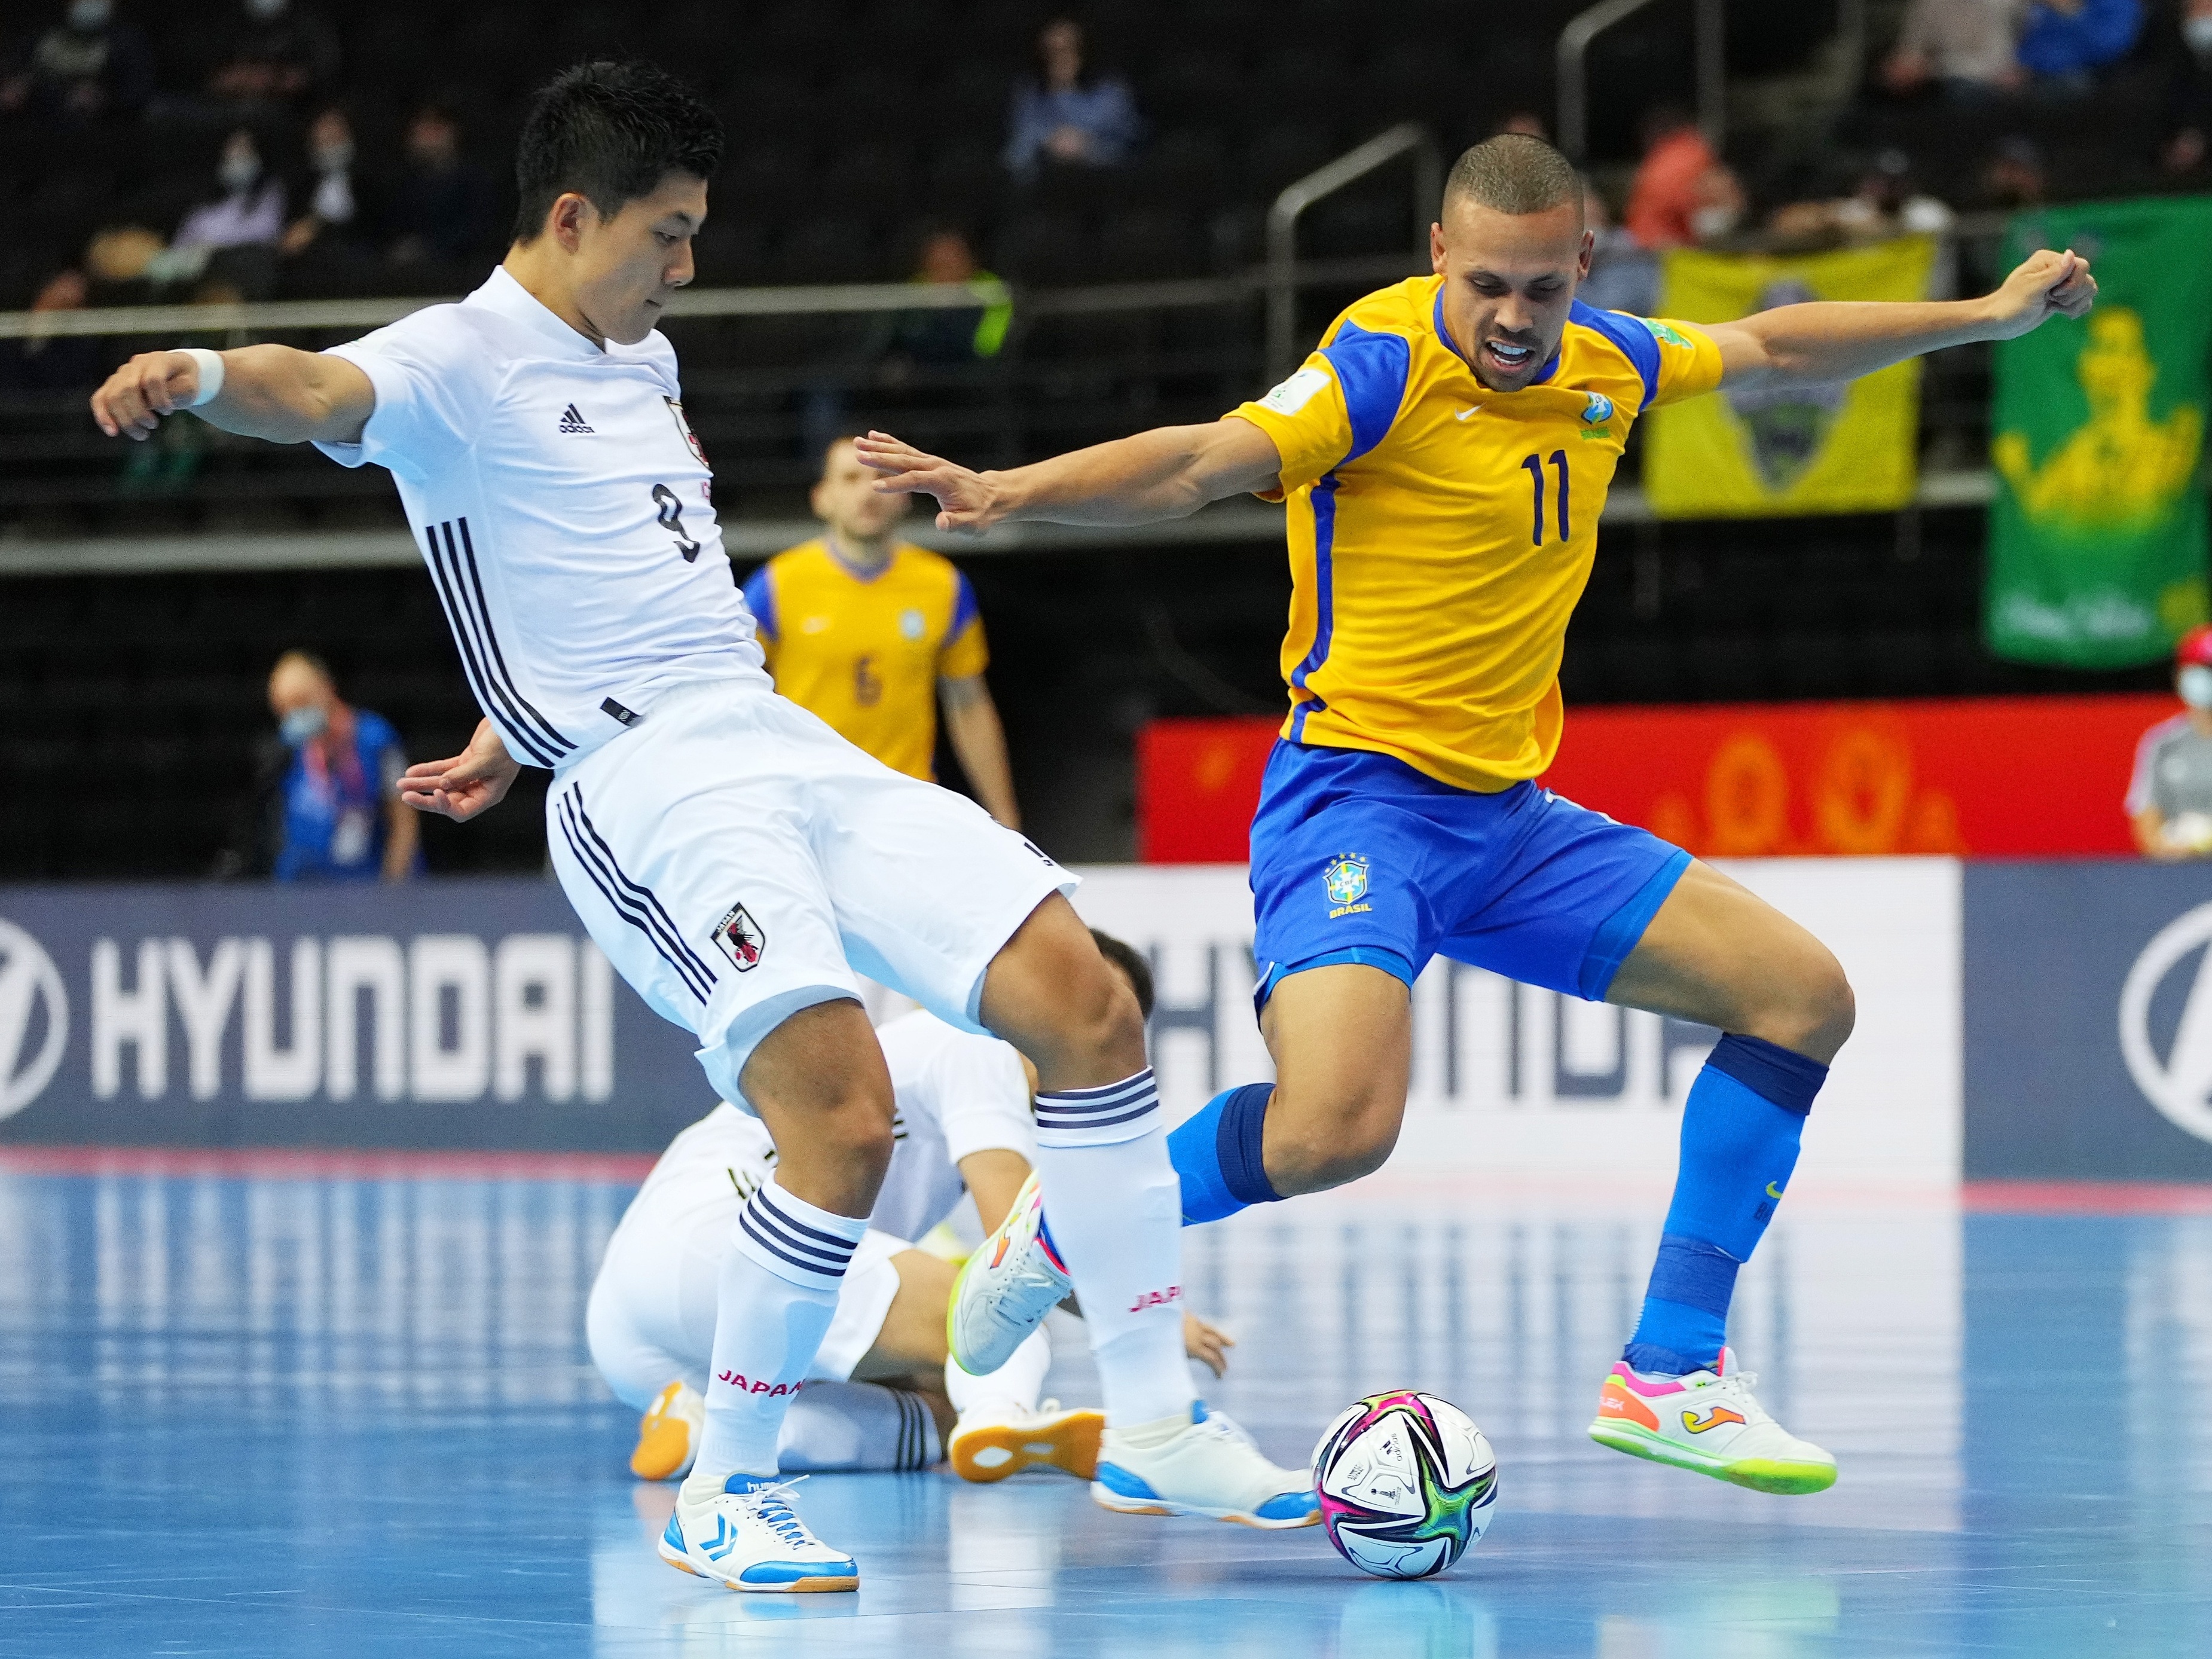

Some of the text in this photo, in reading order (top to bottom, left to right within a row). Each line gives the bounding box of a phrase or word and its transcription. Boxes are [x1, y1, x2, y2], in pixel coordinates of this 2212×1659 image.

[652, 483, 701, 563] 9
[1520, 450, 1569, 546] 11
[853, 655, 882, 707] 6
[1329, 903, 1373, 919] BRASIL
[90, 934, 615, 1102] HYUNDAI
[1129, 1286, 1181, 1312] JAP
